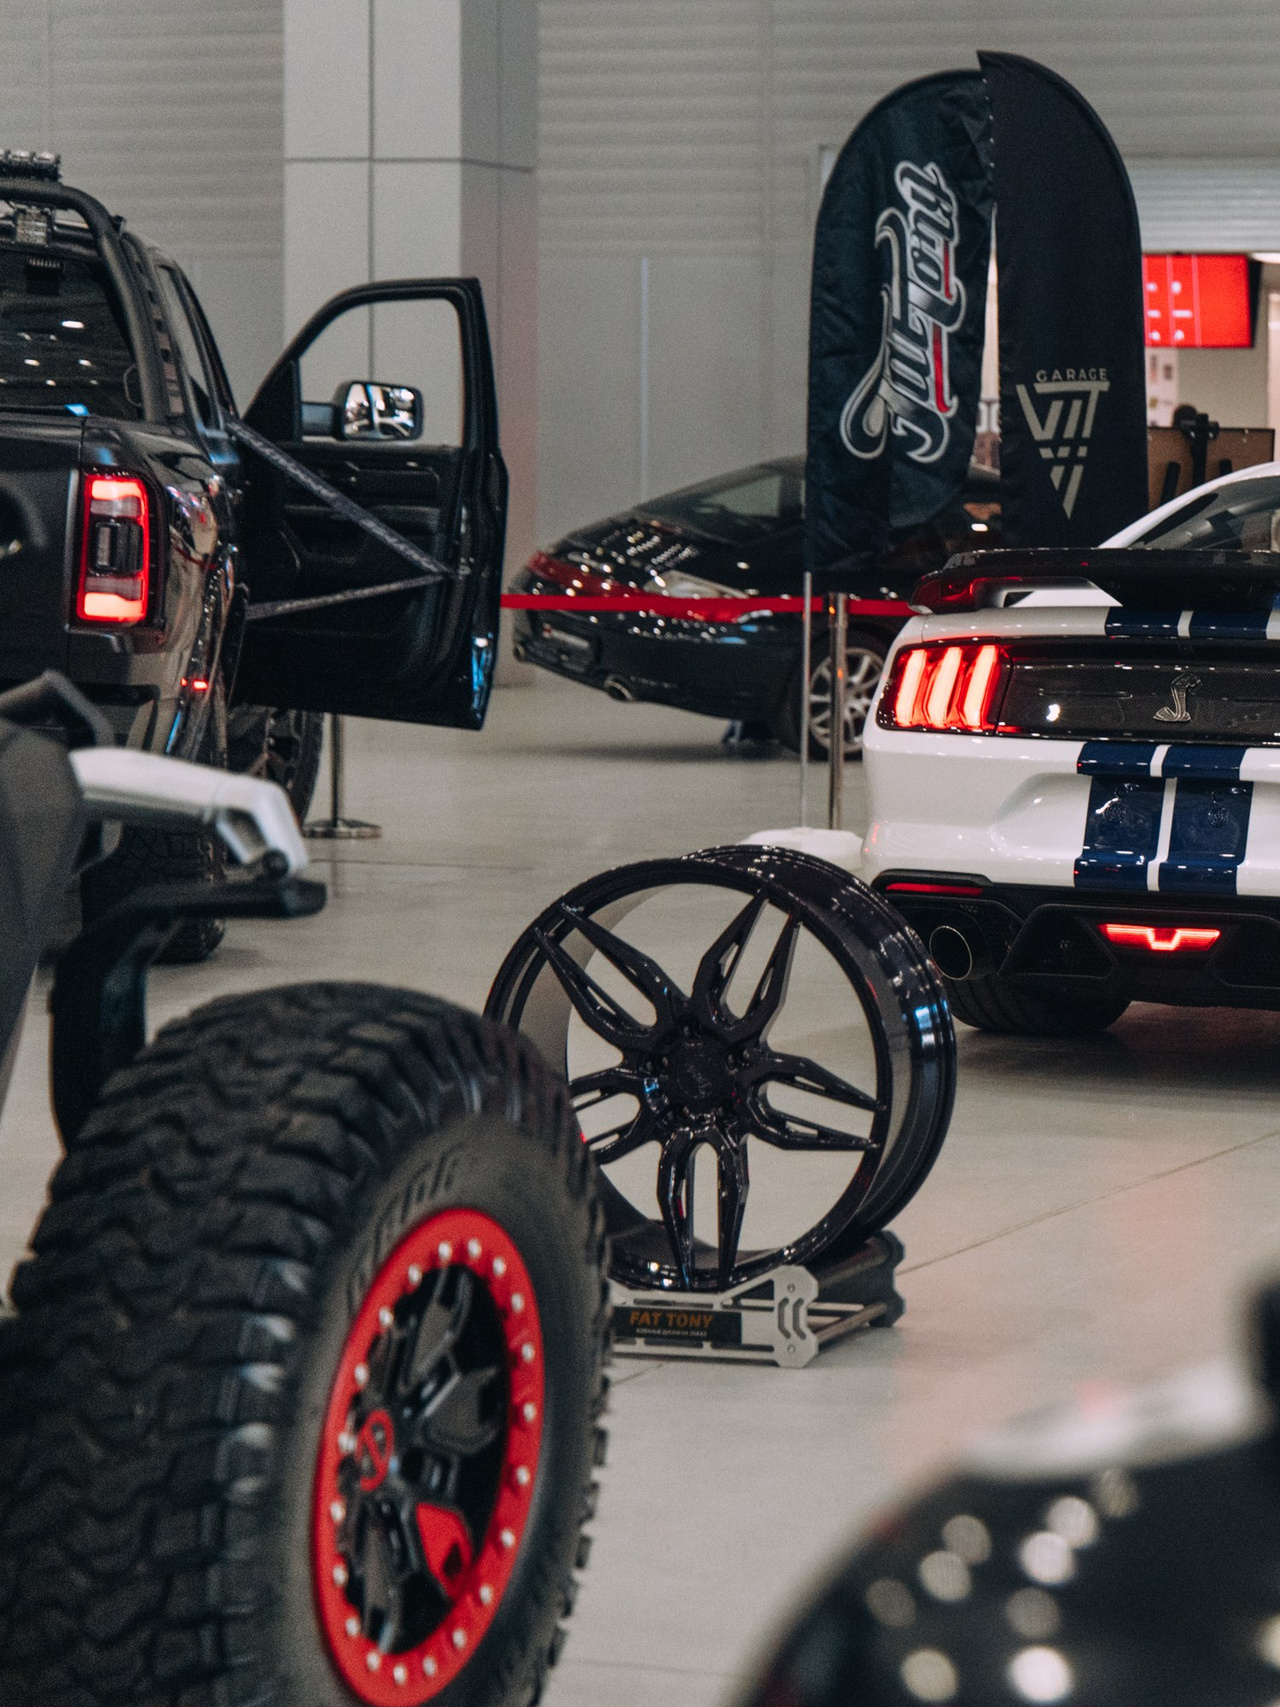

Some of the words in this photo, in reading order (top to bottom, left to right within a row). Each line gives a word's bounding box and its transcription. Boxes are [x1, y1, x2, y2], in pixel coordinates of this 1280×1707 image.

[1036, 368, 1108, 382] GARAGE
[630, 1311, 662, 1326] FAT
[666, 1312, 714, 1329] TONY
